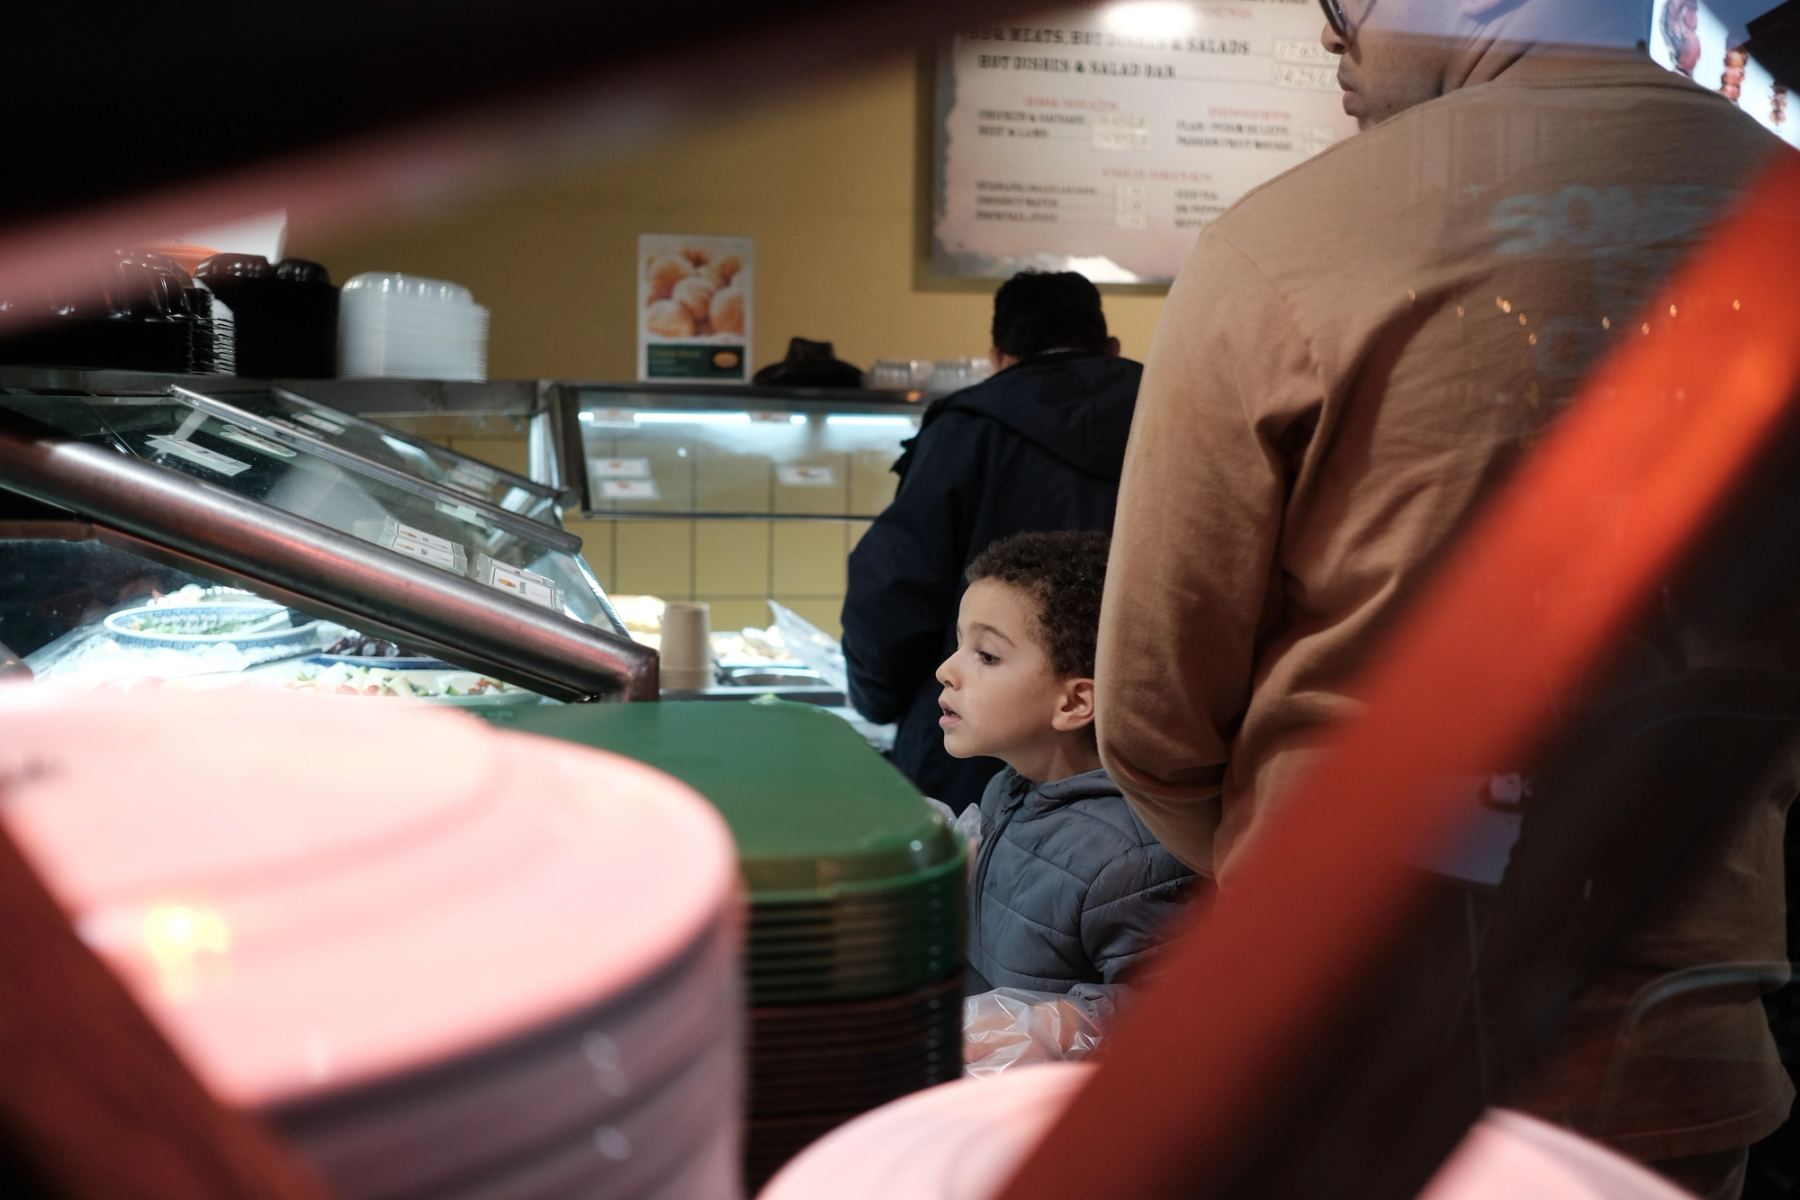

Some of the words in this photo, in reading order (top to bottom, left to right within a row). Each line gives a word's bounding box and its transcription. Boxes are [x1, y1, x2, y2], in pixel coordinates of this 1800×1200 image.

[1186, 37, 1250, 56] SALADS
[977, 53, 1010, 71] HOT
[1013, 55, 1070, 74] DISHES
[1074, 59, 1085, 75] &
[1089, 60, 1140, 77] SALAD
[1143, 63, 1176, 80] BAR
